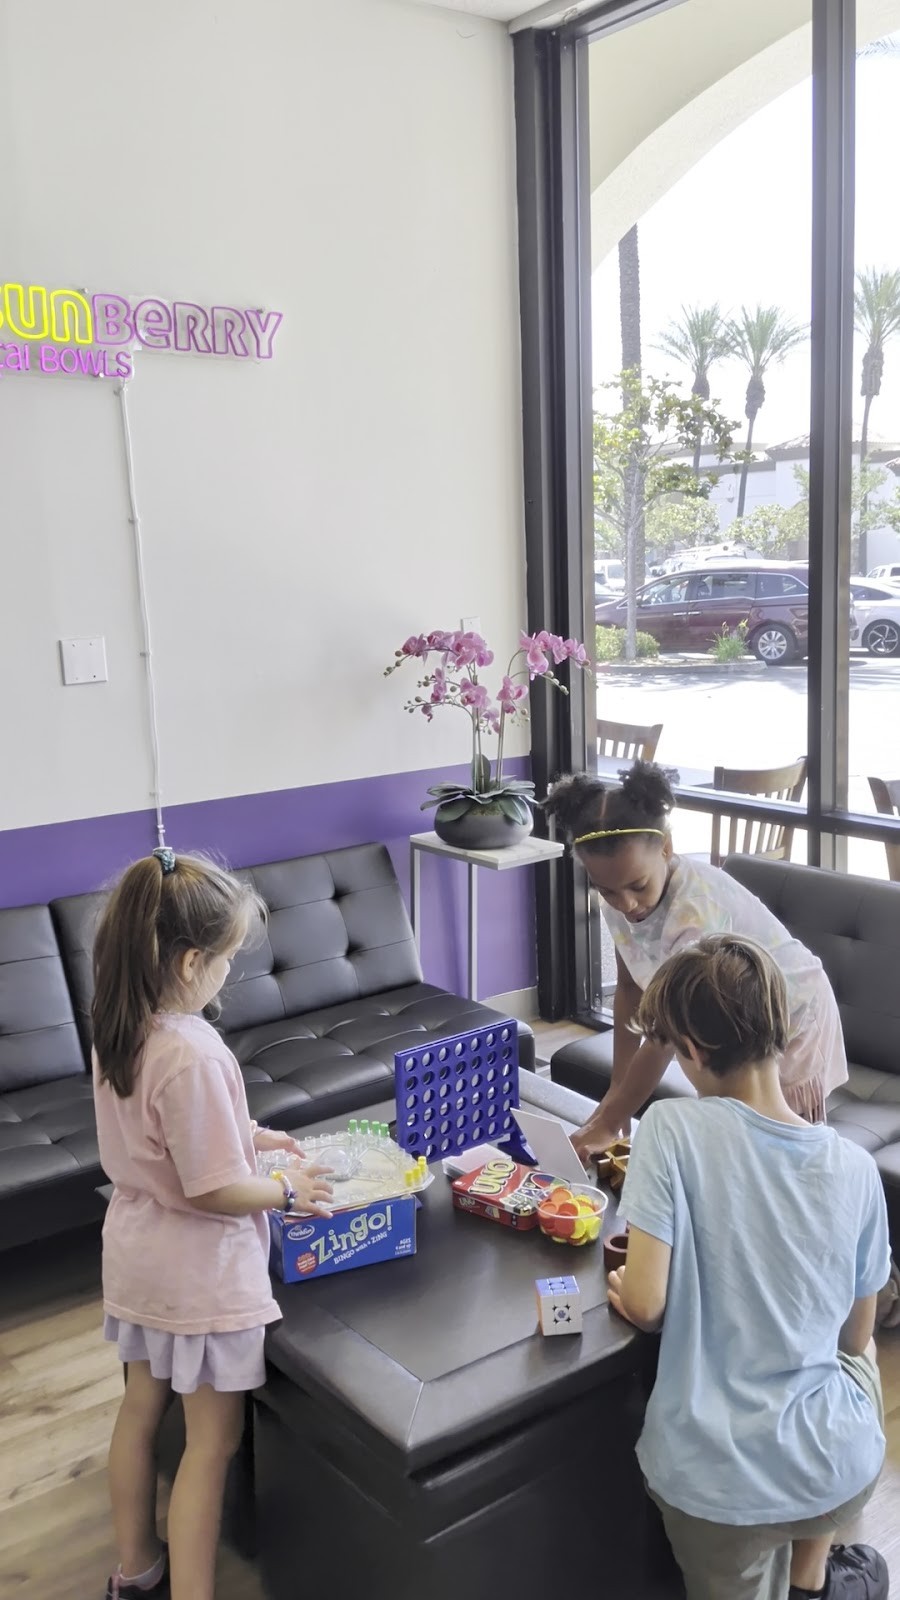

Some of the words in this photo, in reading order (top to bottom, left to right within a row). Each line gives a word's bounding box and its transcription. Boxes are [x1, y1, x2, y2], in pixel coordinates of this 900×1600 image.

[40, 344, 132, 378] BOWLS
[469, 1158, 516, 1194] UNO
[310, 1205, 393, 1264] Zingo!
[333, 1249, 355, 1264] BINGO
[371, 1231, 388, 1244] ZING
